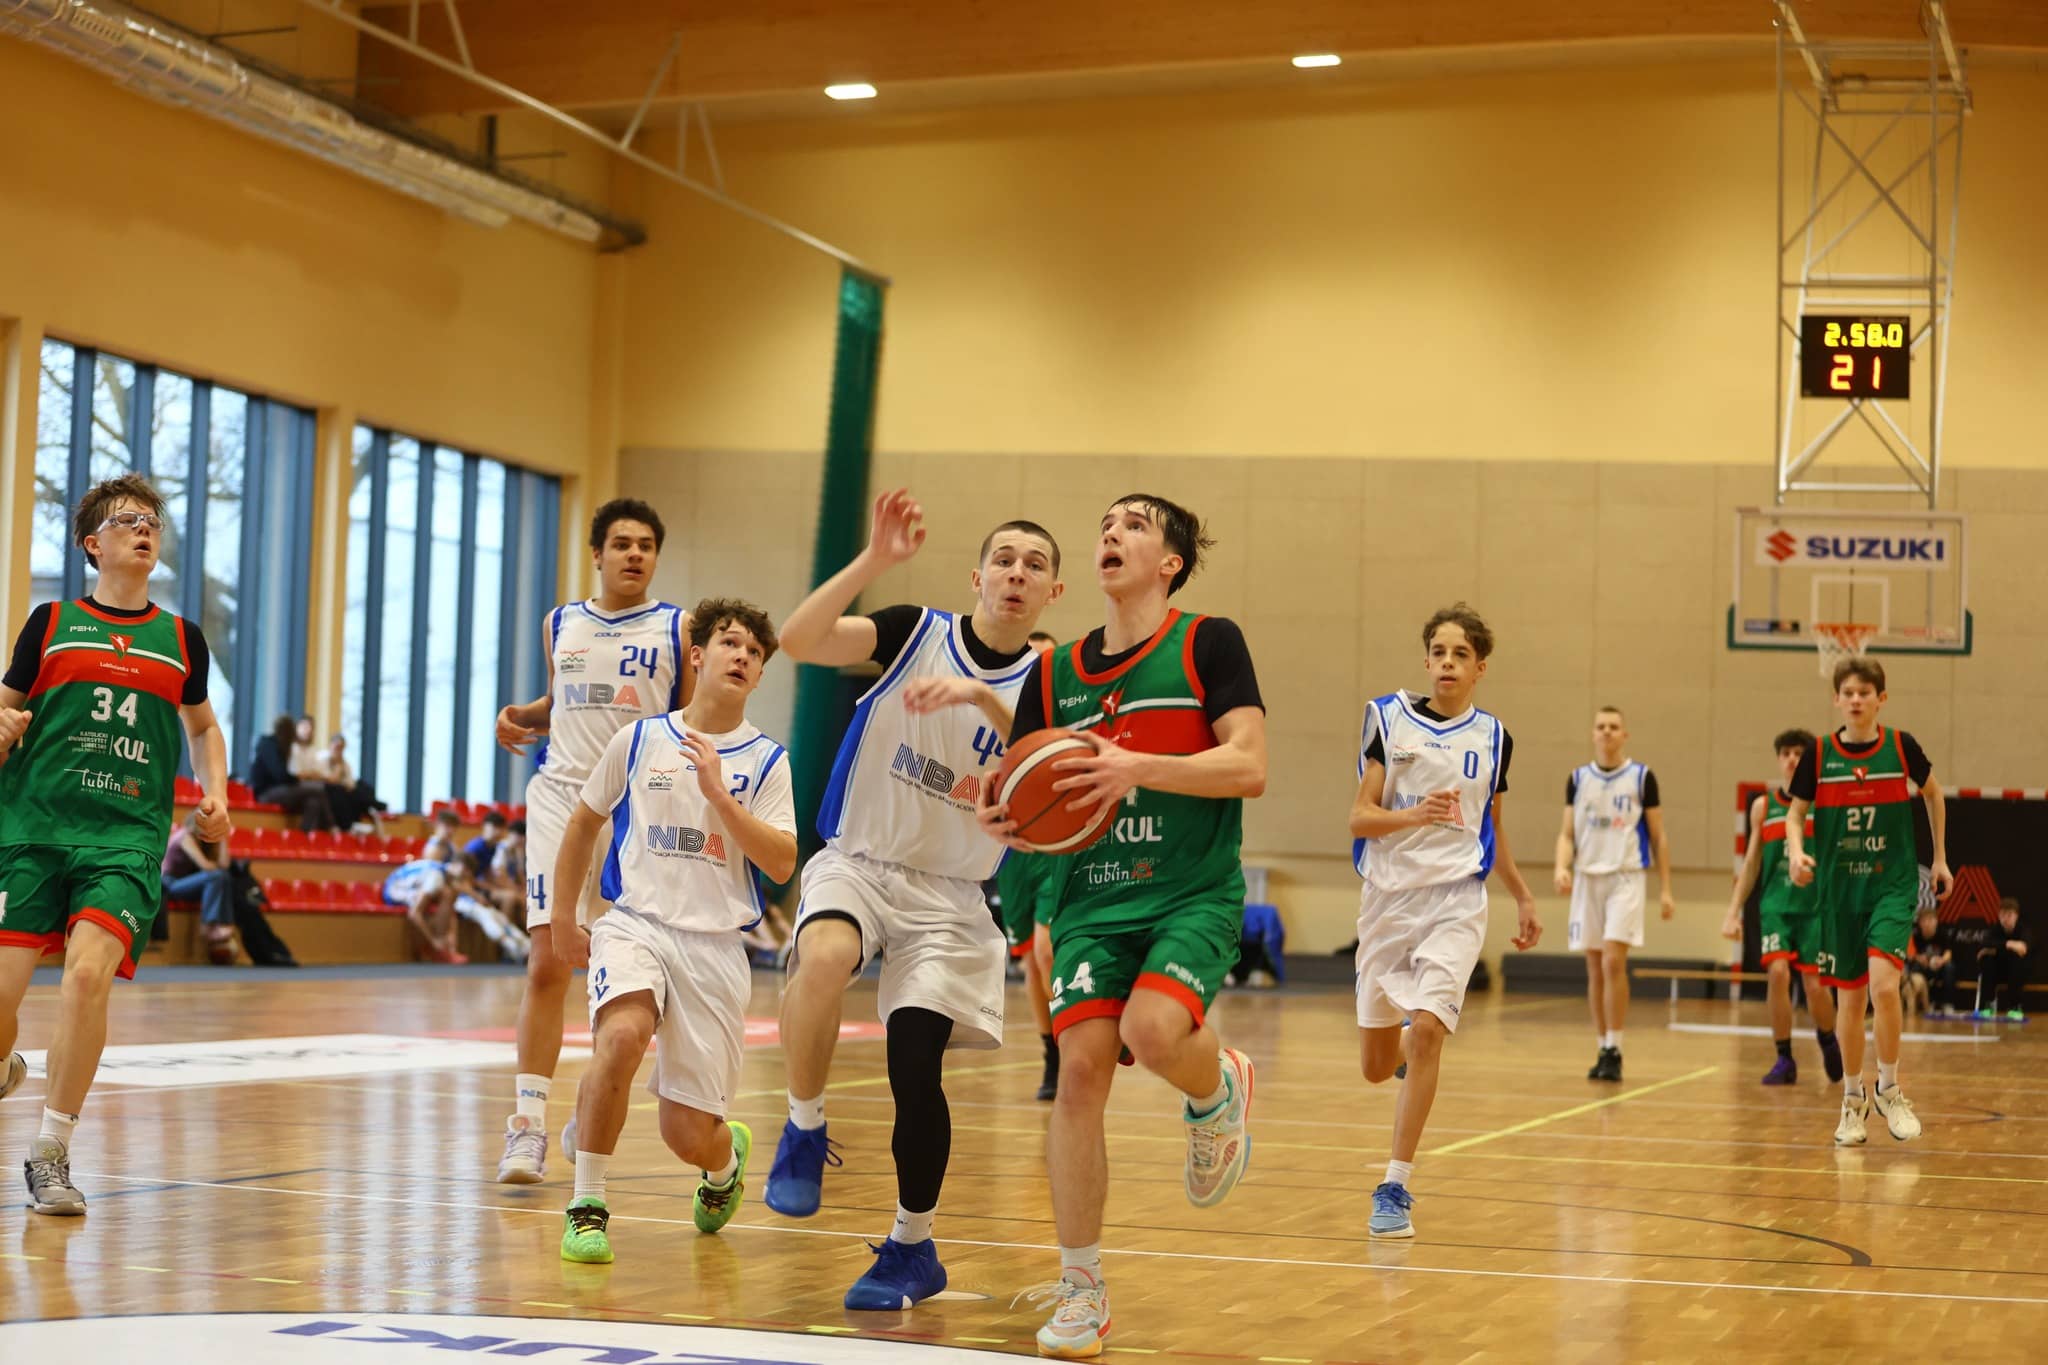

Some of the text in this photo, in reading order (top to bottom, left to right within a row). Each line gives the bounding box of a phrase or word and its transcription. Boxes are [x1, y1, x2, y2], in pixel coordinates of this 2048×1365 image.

[1806, 537, 1945, 561] SUZUKI
[69, 625, 99, 633] PEHA
[619, 645, 658, 680] 24
[91, 686, 138, 727] 34
[564, 683, 641, 709] NBA
[1059, 695, 1088, 709] PEHA
[113, 736, 149, 765] KUL
[972, 725, 1005, 767] 4
[892, 742, 981, 805] NBA
[1463, 750, 1479, 779] 0
[1115, 816, 1162, 843] KUL
[1847, 805, 1876, 831] 27
[647, 825, 727, 862] NBA
